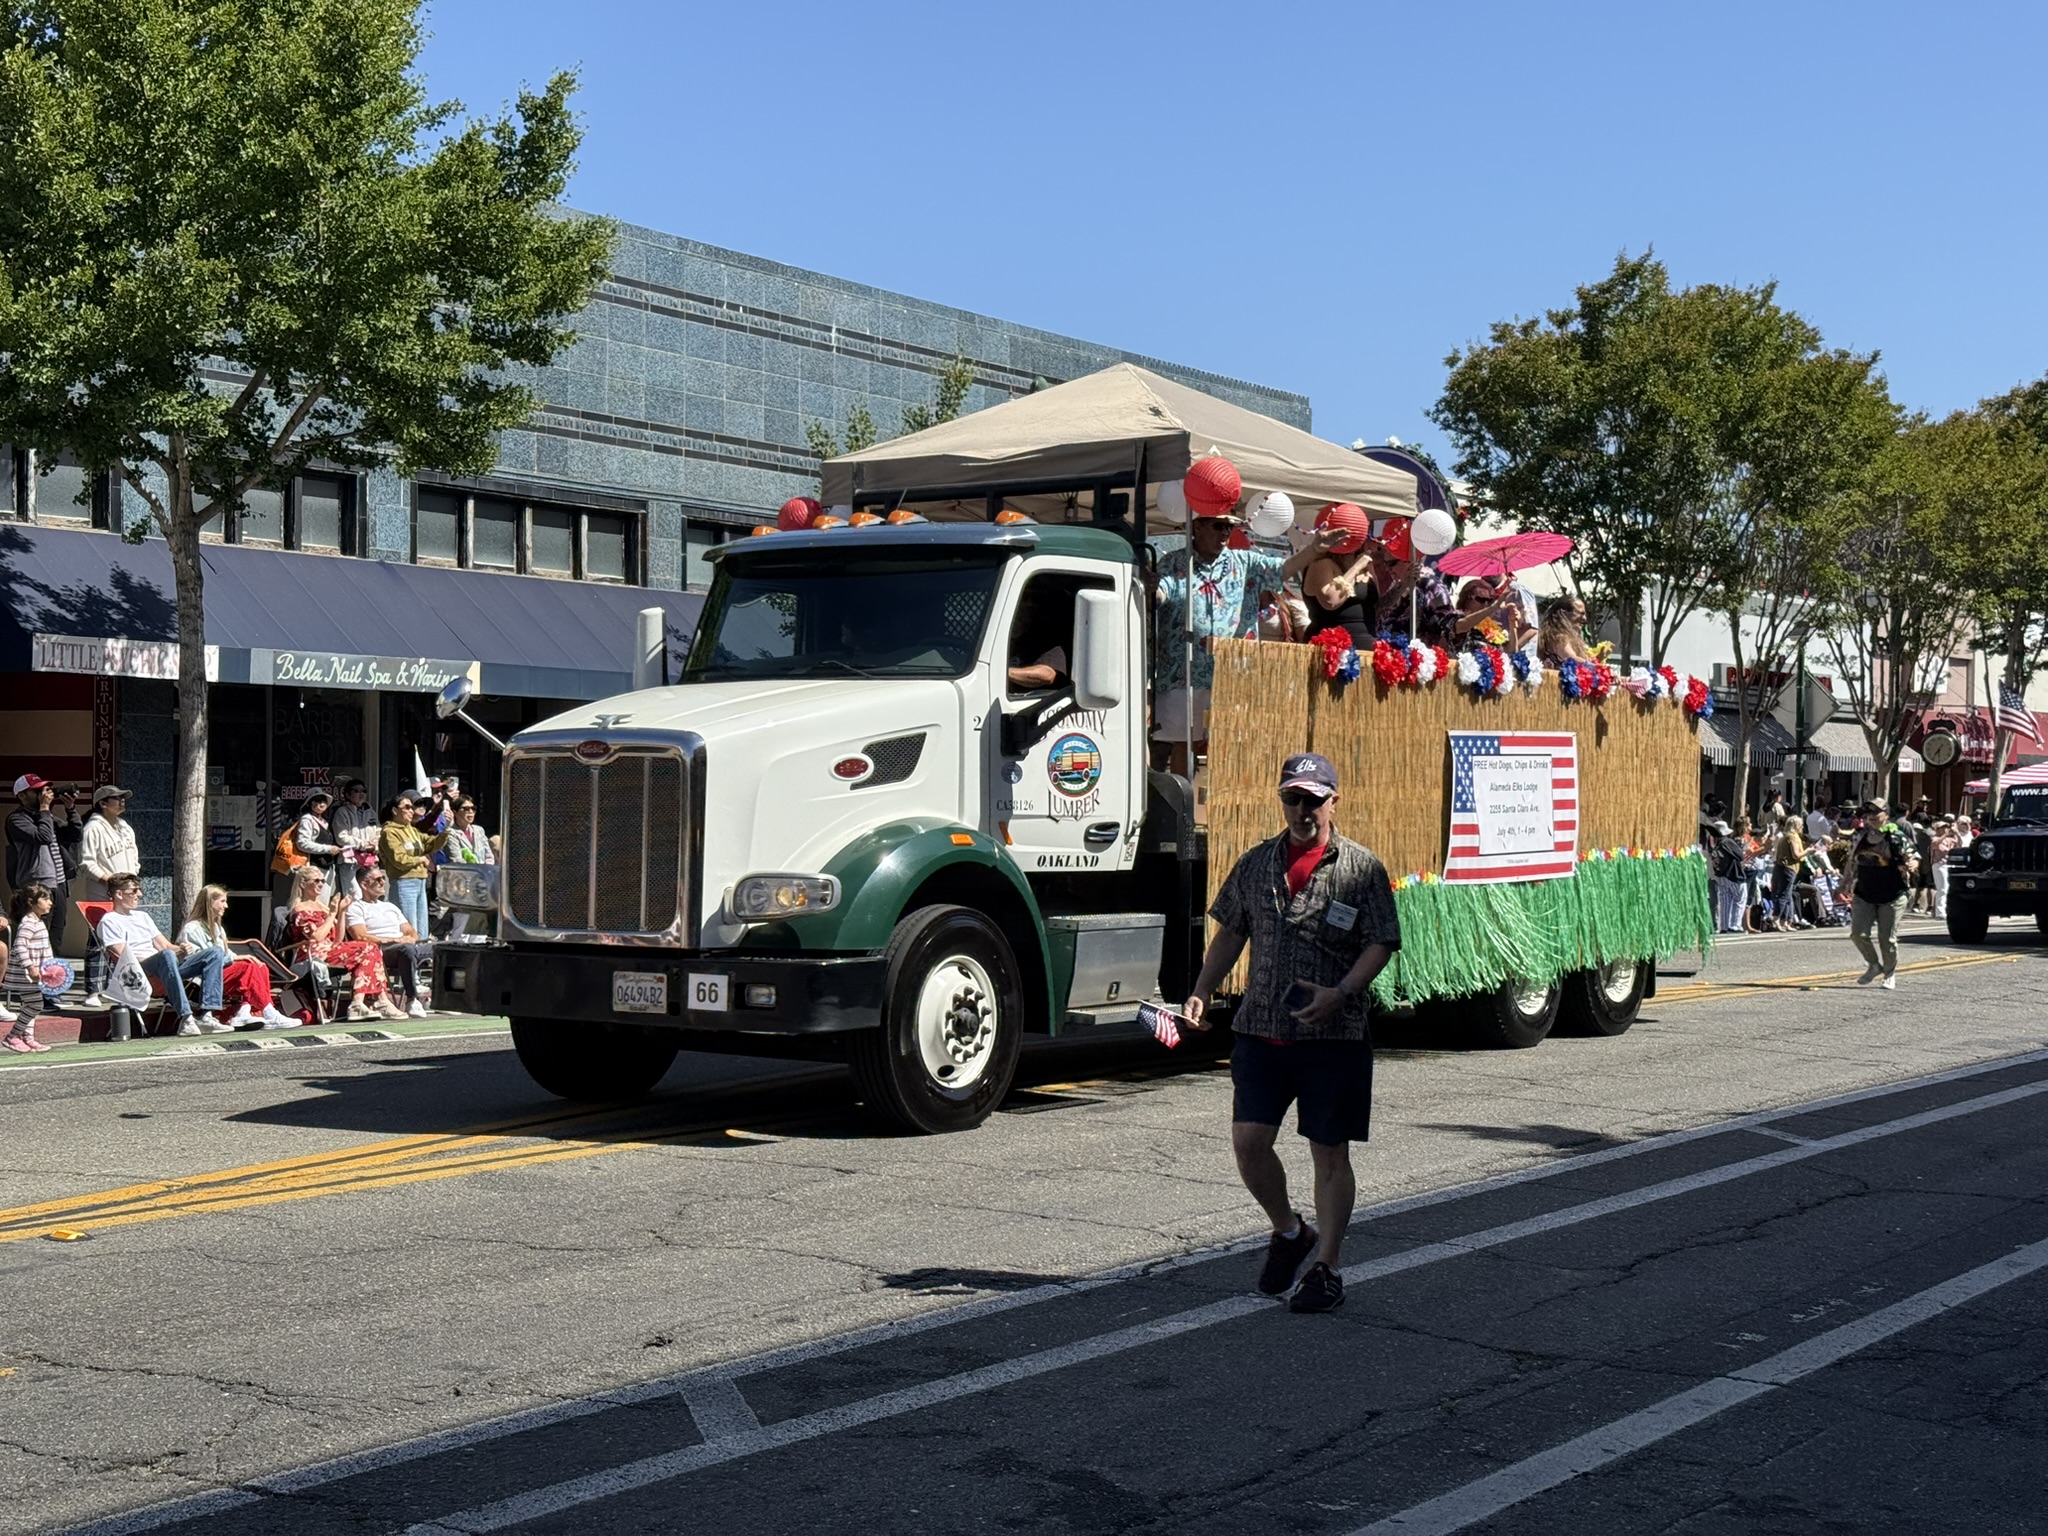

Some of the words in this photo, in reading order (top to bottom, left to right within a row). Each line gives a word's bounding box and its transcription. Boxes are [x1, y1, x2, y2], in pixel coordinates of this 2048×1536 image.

[40, 641, 97, 671] LITTLE
[101, 644, 167, 676] PSYCHIC
[276, 653, 323, 681] Bella
[324, 656, 362, 684] Nail
[365, 662, 391, 689] Spa
[396, 662, 408, 686] &
[274, 708, 359, 736] BARBER
[973, 715, 982, 731] 2
[1042, 705, 1107, 740] ONOMY
[287, 739, 346, 765] SHOP
[1474, 760, 1488, 769] FREE
[1488, 760, 1498, 769] Hot
[1499, 760, 1513, 771] Dogs,
[1514, 760, 1528, 771] Chips
[1529, 760, 1533, 769] &
[1533, 760, 1548, 769] Drinks
[301, 767, 330, 785] TK
[1489, 782, 1511, 792] Alameda
[1512, 782, 1522, 791] Elks
[1523, 782, 1538, 793] Lodge
[1046, 786, 1100, 823] LUMBER
[1502, 804, 1516, 813] Santa
[1497, 826, 1506, 838] July
[1037, 854, 1099, 868] OAKLAND
[616, 985, 663, 1004] 06494B2
[696, 982, 718, 1003] 66
